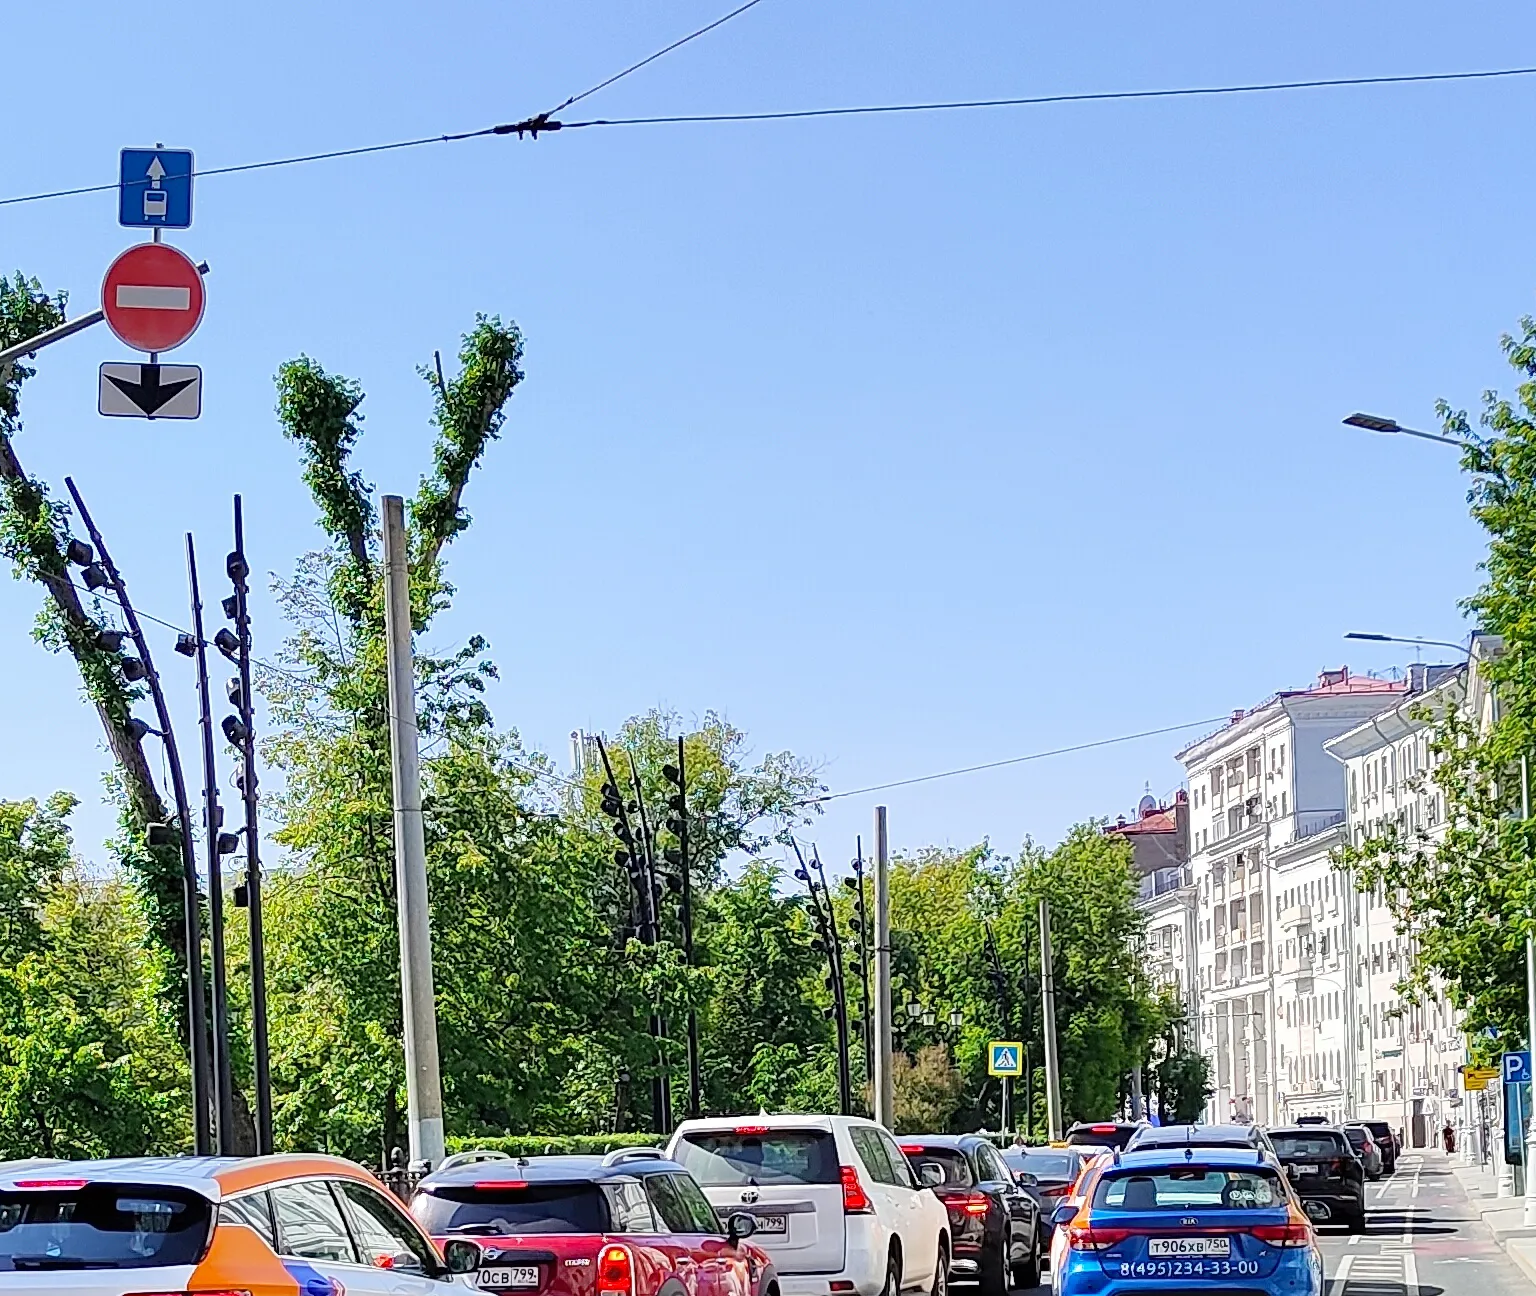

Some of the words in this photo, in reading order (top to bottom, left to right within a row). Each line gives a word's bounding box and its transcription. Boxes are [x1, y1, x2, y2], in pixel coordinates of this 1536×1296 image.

[1505, 1055, 1523, 1081] P
[513, 1268, 535, 1280] 799
[1119, 1260, 1259, 1278] 8(495)234-33-00
